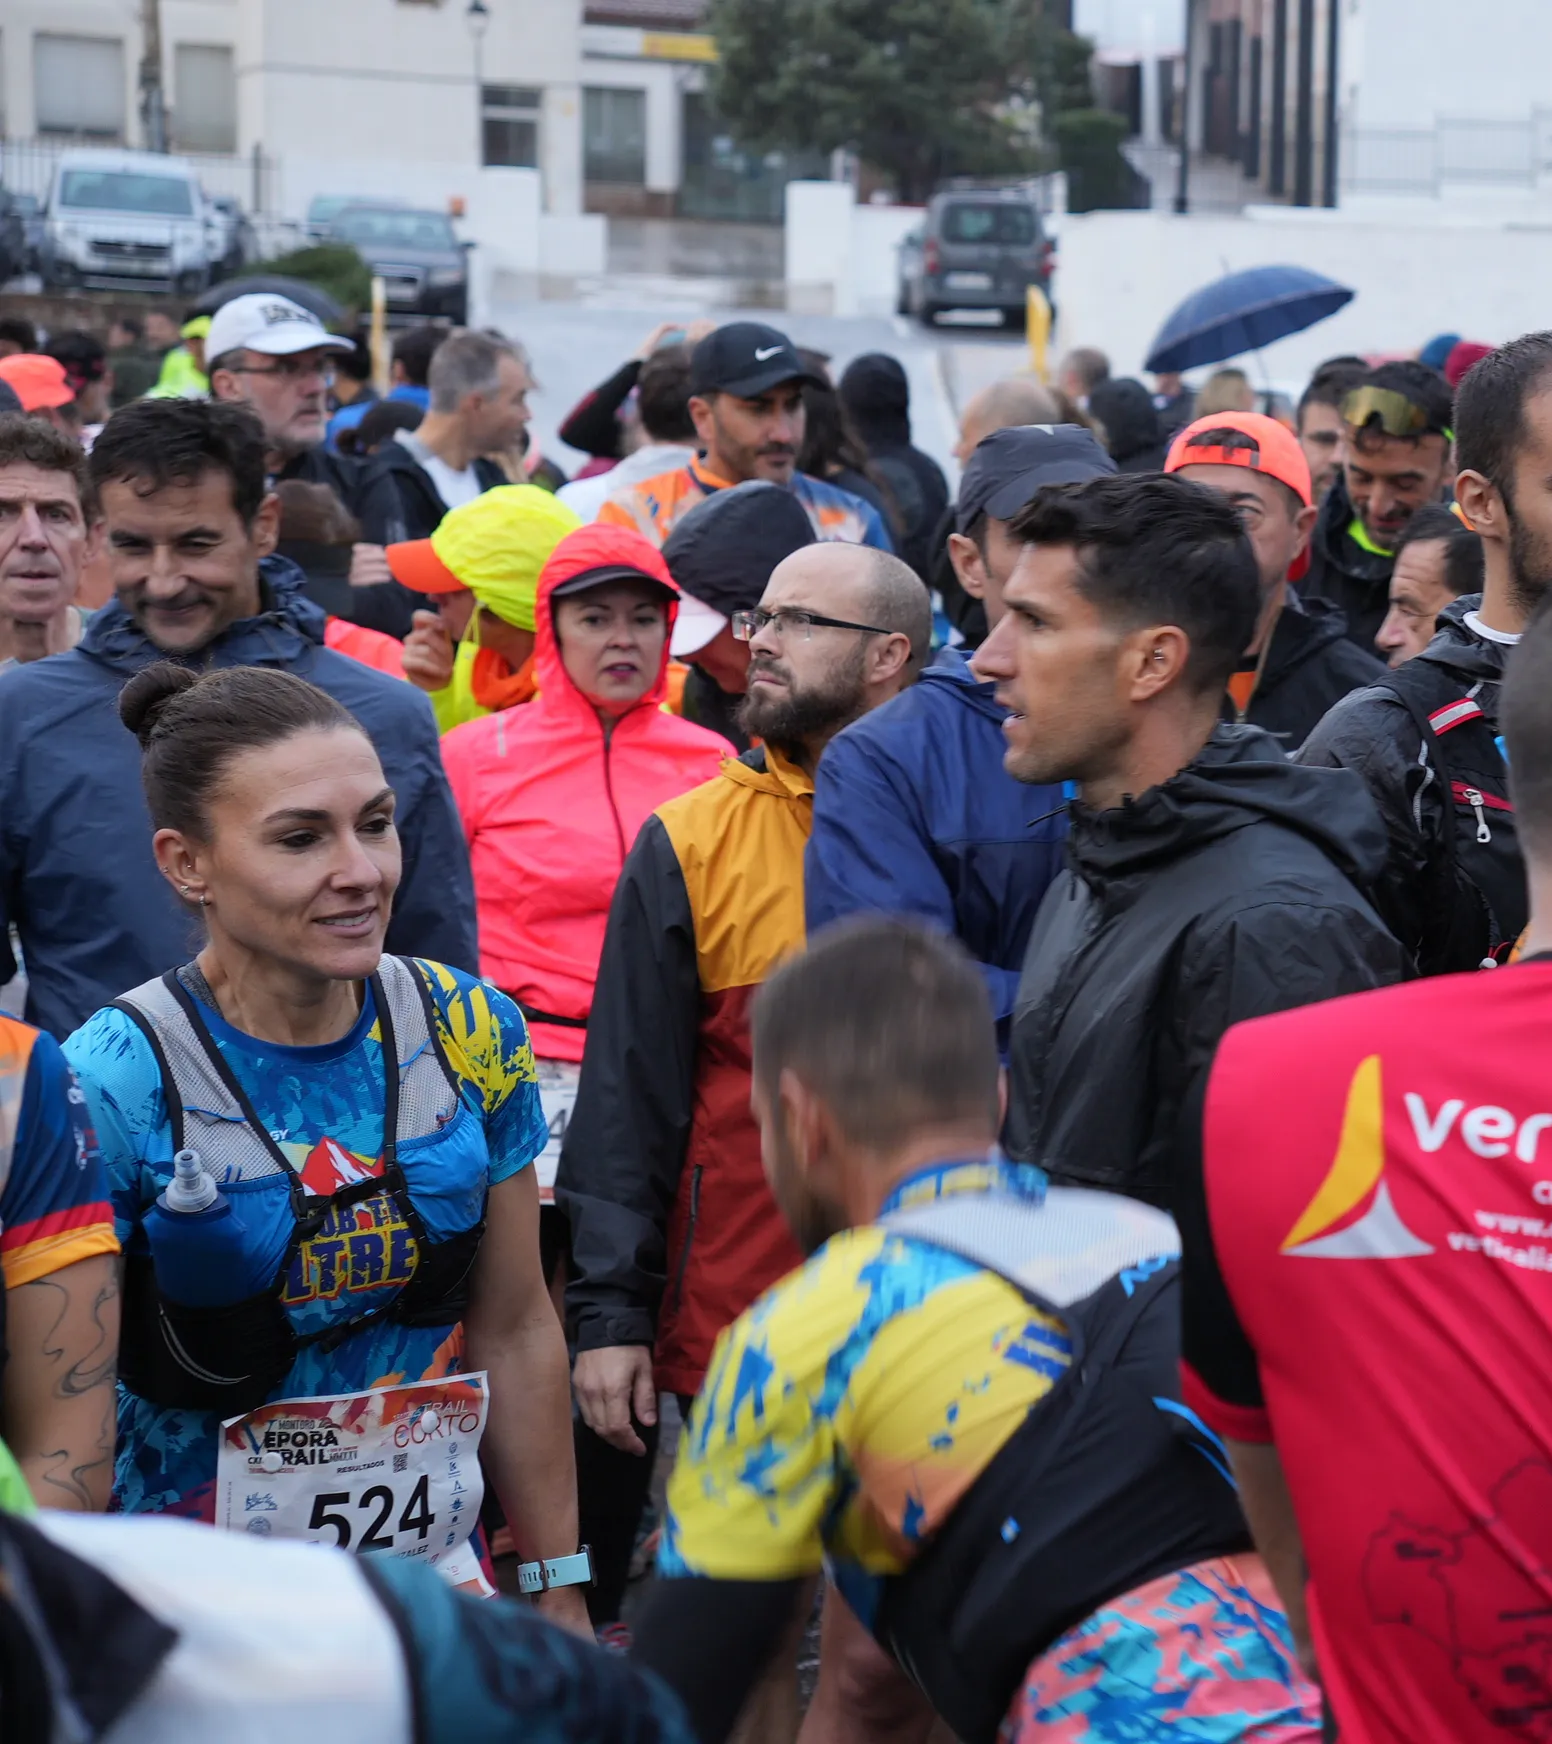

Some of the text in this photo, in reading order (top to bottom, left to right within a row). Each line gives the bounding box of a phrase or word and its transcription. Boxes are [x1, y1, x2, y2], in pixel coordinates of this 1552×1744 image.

[264, 1430, 339, 1449] EPORA
[336, 1460, 385, 1474] RESULTADOS
[307, 1473, 436, 1555] 524
